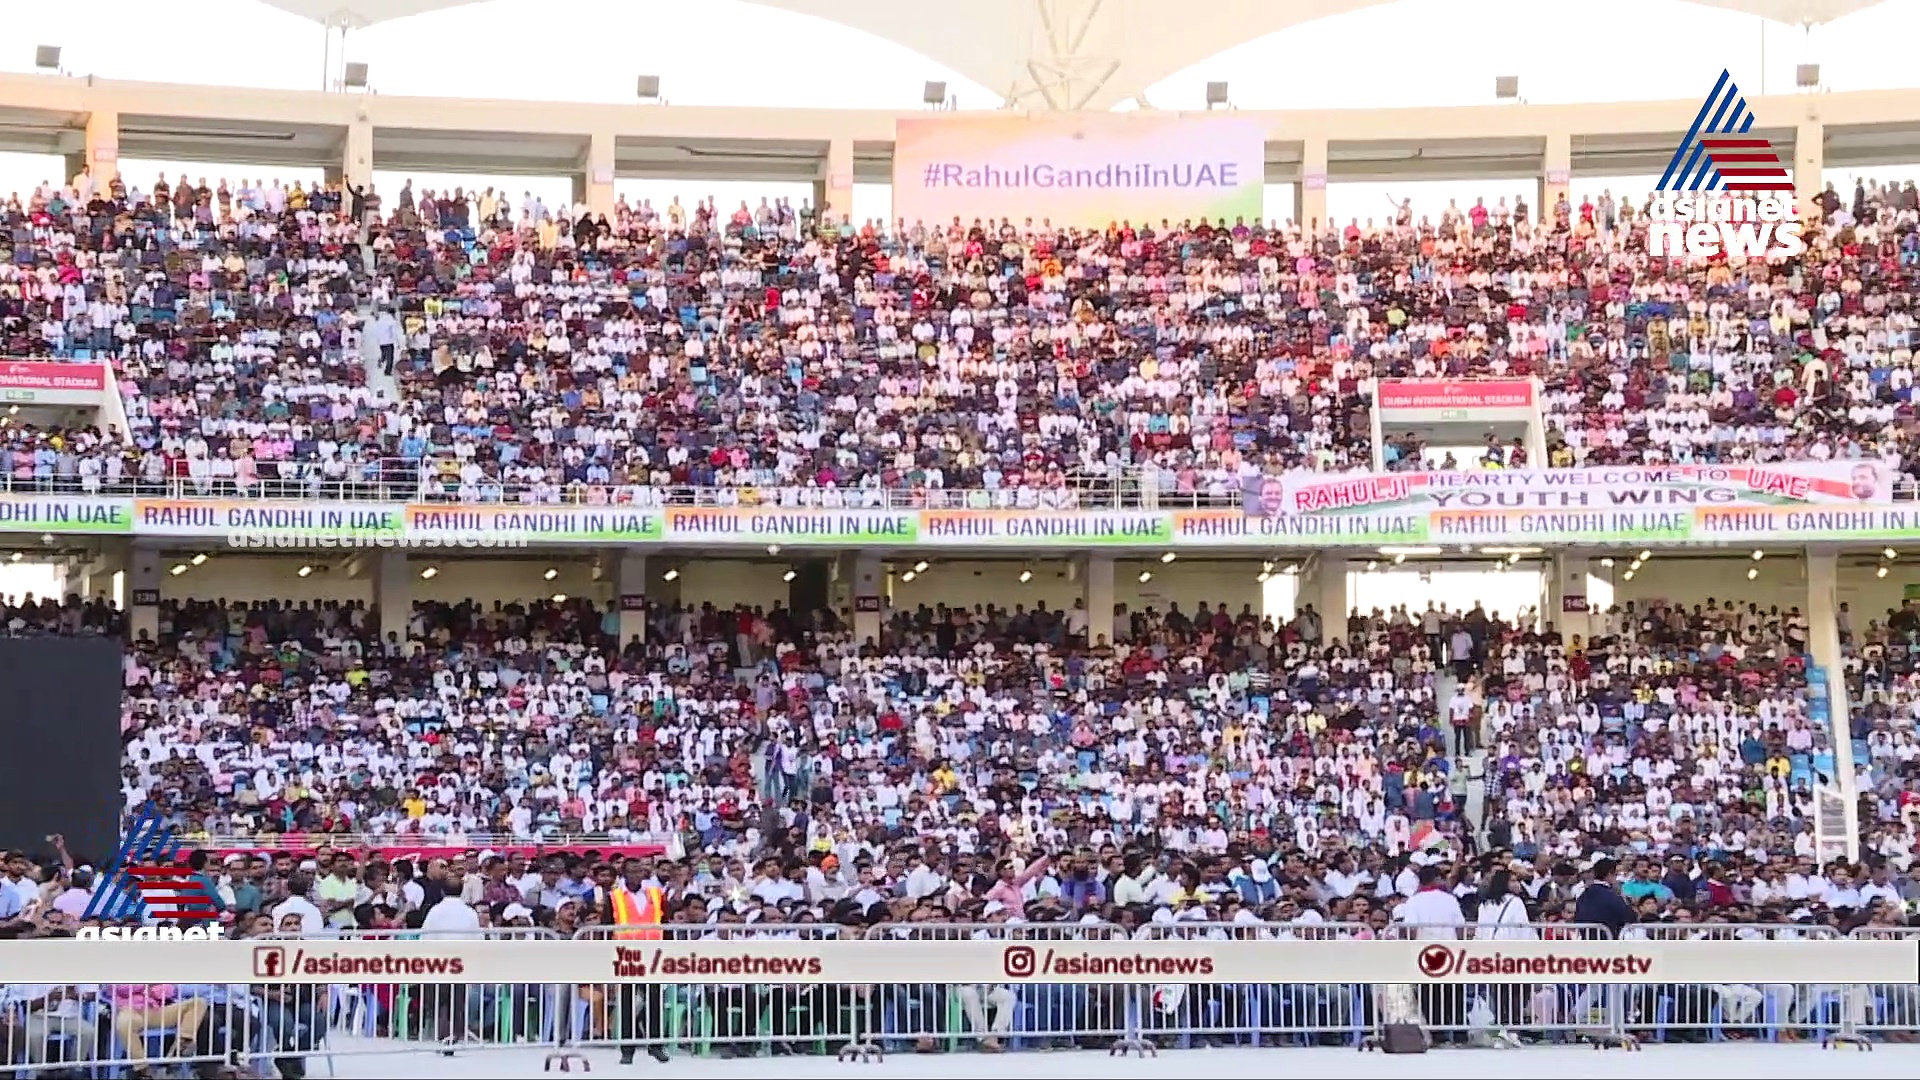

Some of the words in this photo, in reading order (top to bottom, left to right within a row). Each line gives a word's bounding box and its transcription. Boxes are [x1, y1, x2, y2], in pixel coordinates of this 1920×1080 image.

[924, 163, 1238, 188] #RahulGandhiInUAE
[1413, 395, 1483, 406] INTERNATIONAL
[1294, 475, 1410, 512] RAHULJI
[1429, 472, 1531, 487] HEARTY
[1544, 469, 1680, 485] WELCOME
[1697, 468, 1729, 483] TO
[1747, 467, 1810, 499] UAE
[1429, 490, 1588, 508] YOUTH
[1608, 488, 1736, 506] WING
[0, 502, 36, 521] DHI
[46, 503, 69, 524] IN
[78, 505, 122, 525] UAE
[145, 506, 220, 527] RAHUL
[228, 508, 312, 528] GANDHI
[321, 510, 342, 529] IN
[350, 511, 393, 530] UAE
[413, 512, 483, 531] RAHUL
[494, 513, 575, 532] GANDHI
[584, 514, 604, 533] IN
[612, 514, 654, 533] UAE
[1440, 514, 1511, 534] RAHUL
[1520, 513, 1604, 533] GANDHI
[1612, 512, 1634, 532] IN
[1642, 511, 1686, 532] UAE
[1704, 511, 1779, 531] RAHUL
[1787, 511, 1874, 531] GANDHI
[1883, 510, 1905, 530] IN
[673, 514, 744, 533] RAHUL
[751, 515, 831, 534] GANDHI
[840, 515, 860, 534] IN
[868, 516, 908, 535] UAE
[929, 517, 1001, 536] RAHUL
[1006, 517, 1086, 536] GANDHI
[1094, 517, 1114, 536] IN
[1122, 517, 1164, 536] UAE
[1183, 517, 1254, 536] RAHUL
[1260, 514, 1340, 536] GANDHI
[1348, 515, 1369, 535] IN
[1377, 515, 1419, 534] UAE
